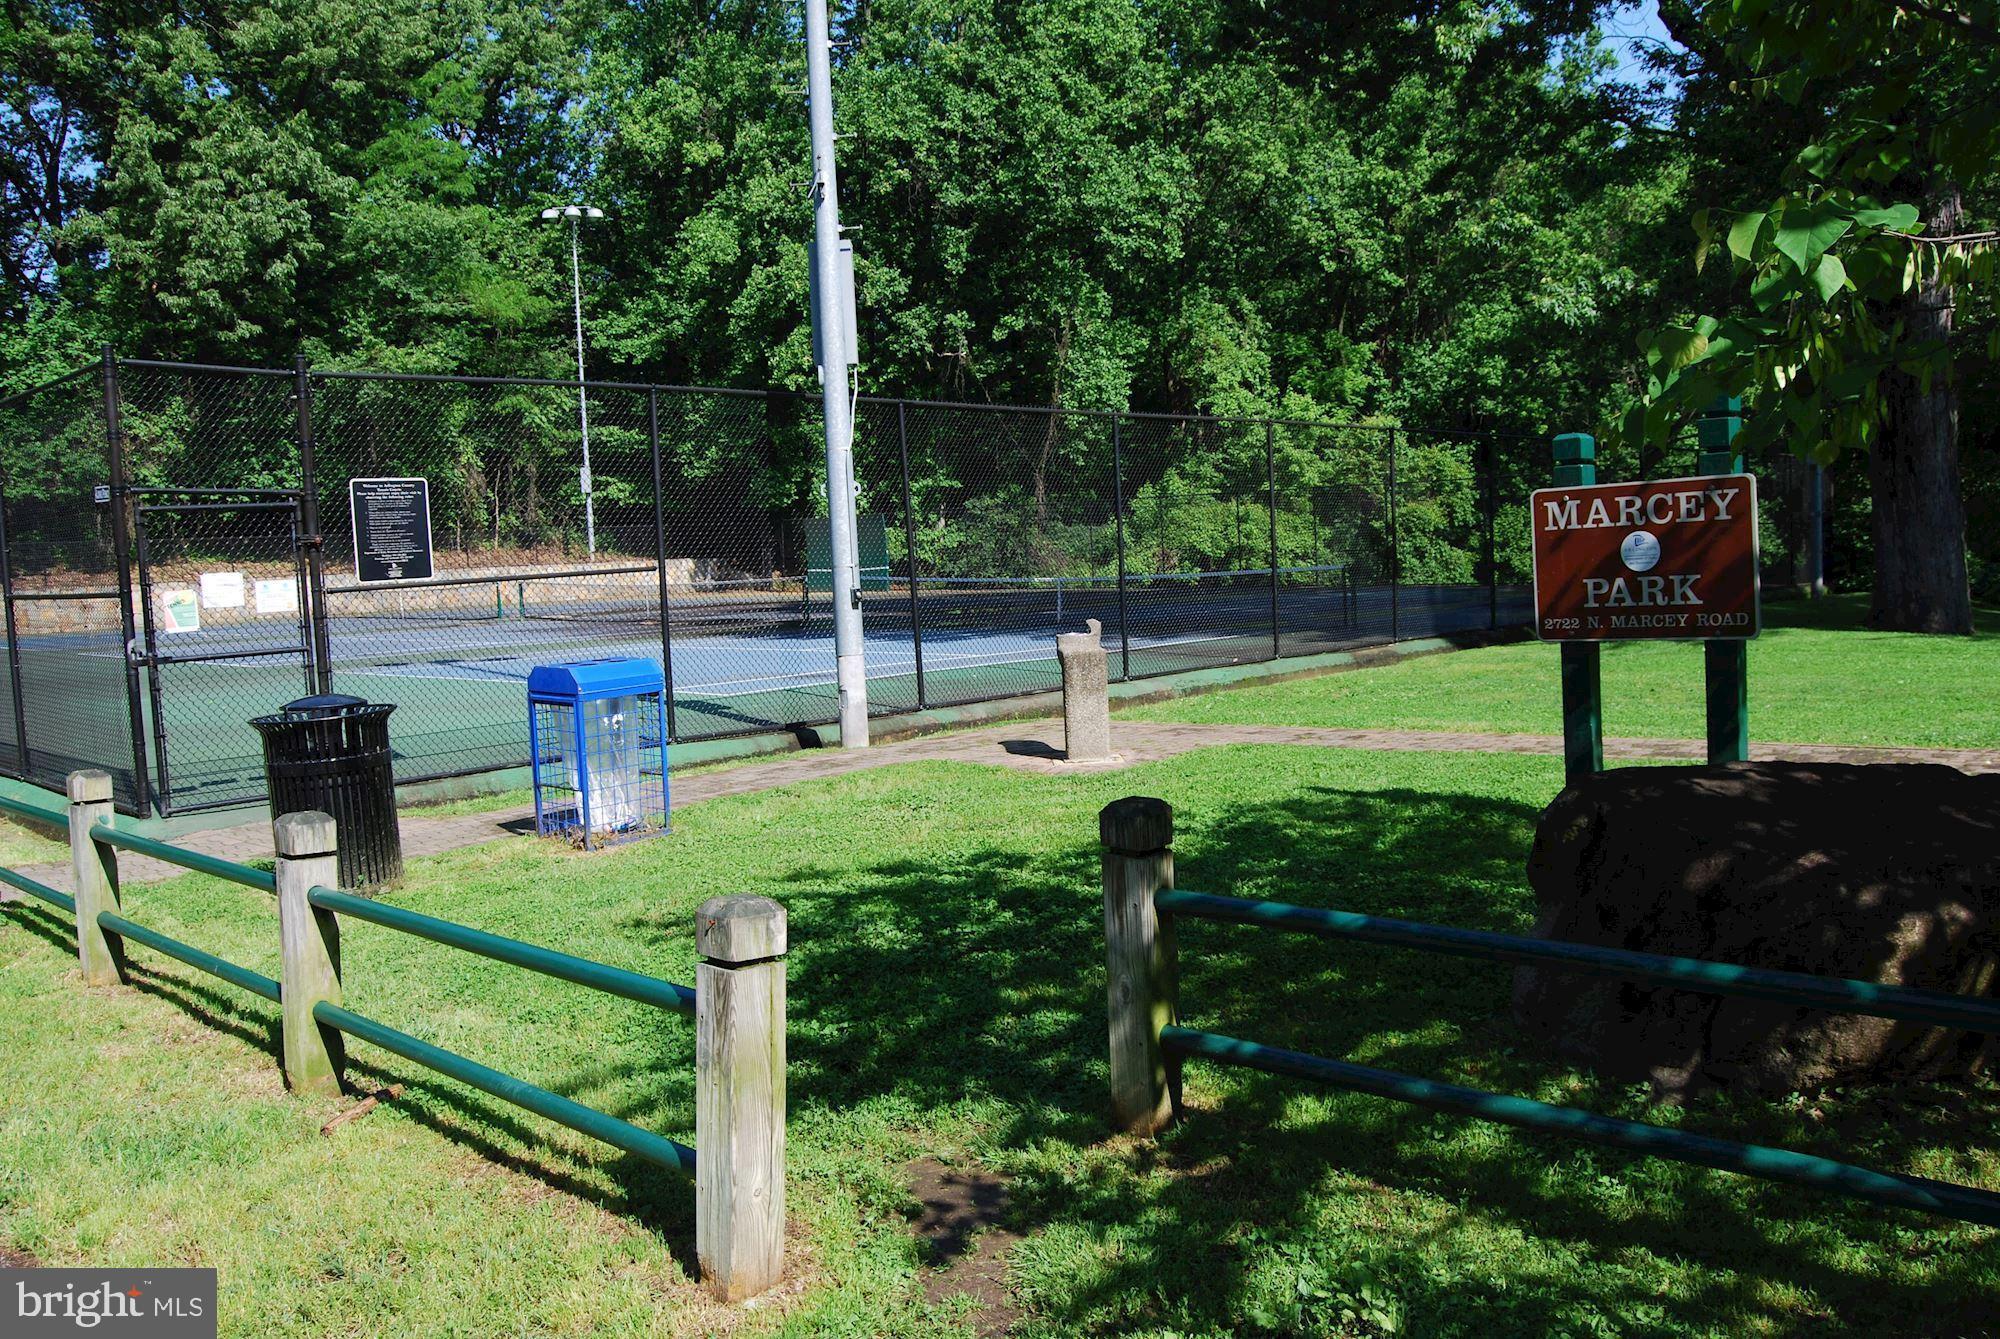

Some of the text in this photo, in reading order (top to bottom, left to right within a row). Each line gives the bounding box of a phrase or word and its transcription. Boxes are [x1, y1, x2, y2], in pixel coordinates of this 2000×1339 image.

[1543, 488, 1739, 531] MARCEY
[1583, 574, 1703, 608] PARK
[1544, 613, 1749, 630] 2722 N. MARCEY ROAD
